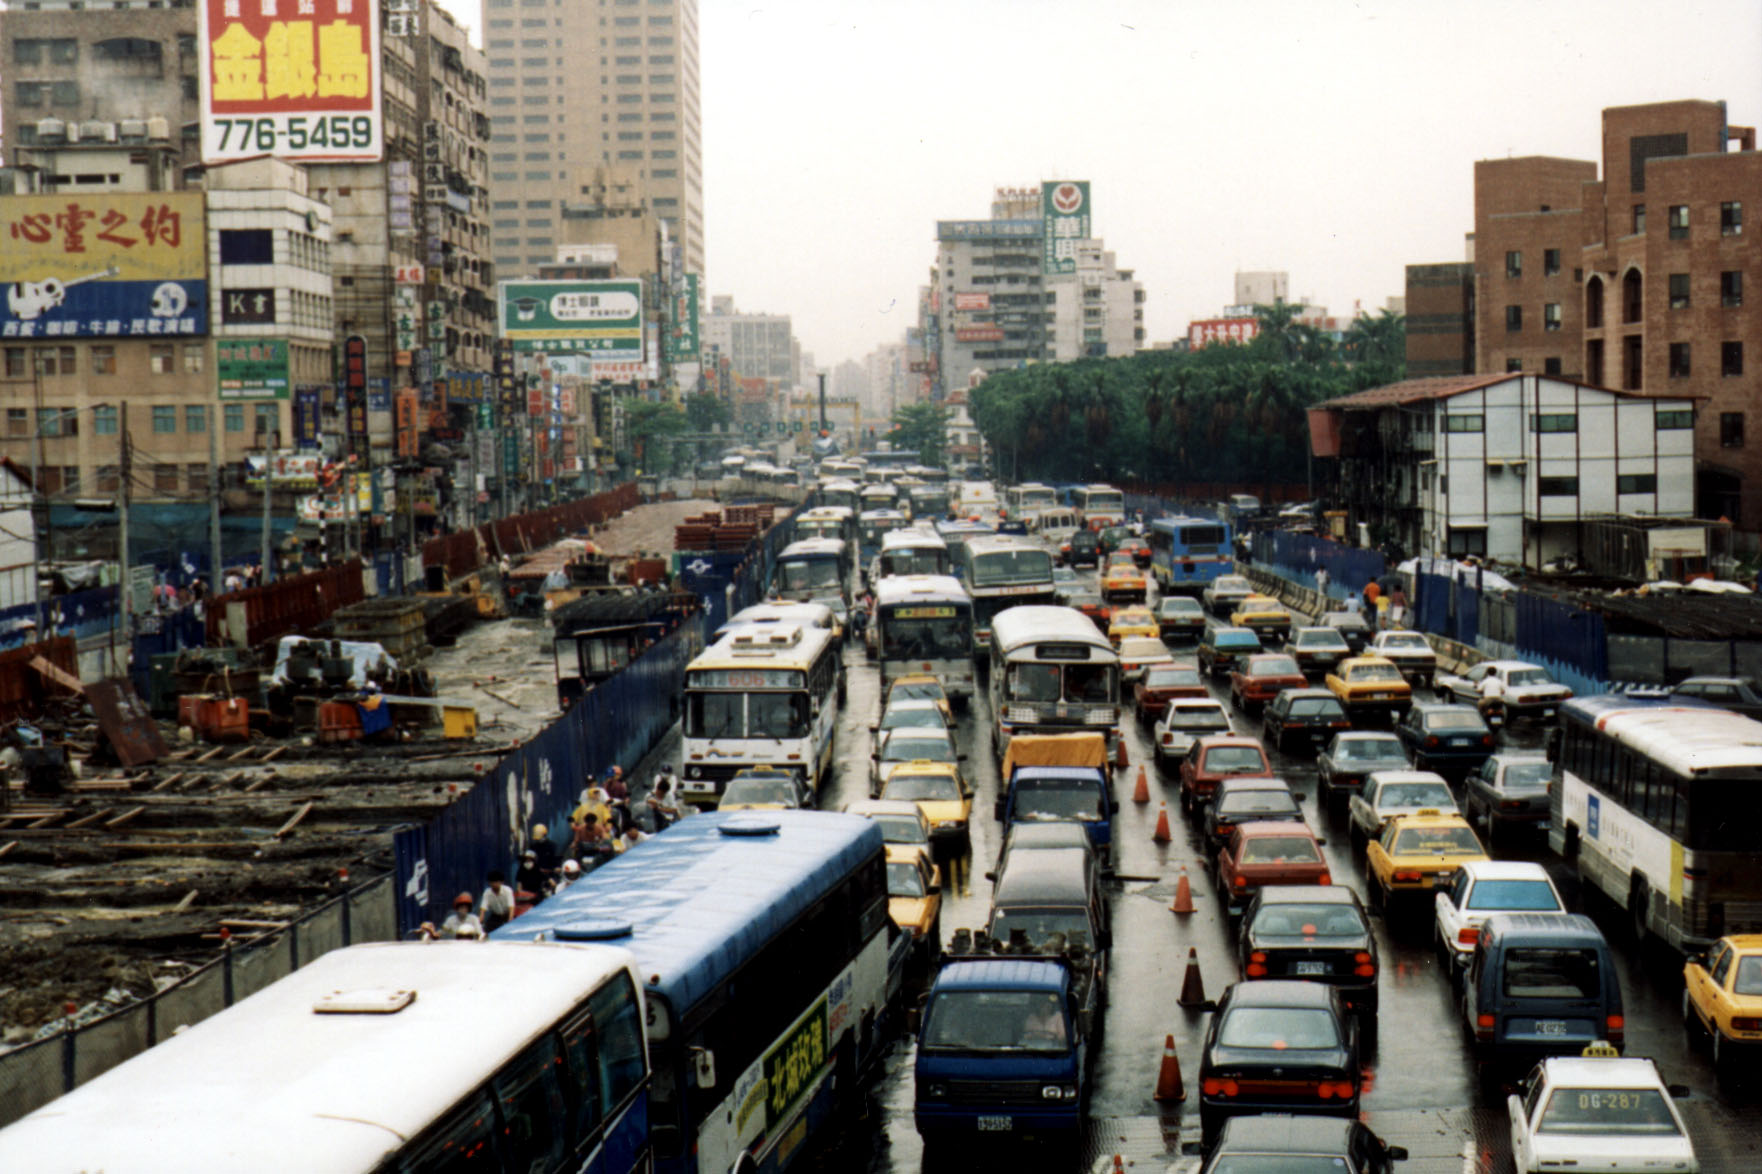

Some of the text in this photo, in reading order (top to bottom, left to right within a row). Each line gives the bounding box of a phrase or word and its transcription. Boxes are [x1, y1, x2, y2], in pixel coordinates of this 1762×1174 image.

[212, 19, 369, 101] 金銀島
[213, 116, 372, 152] 776-5459
[728, 670, 766, 687] 606
[1579, 1095, 1640, 1110] DG-287
